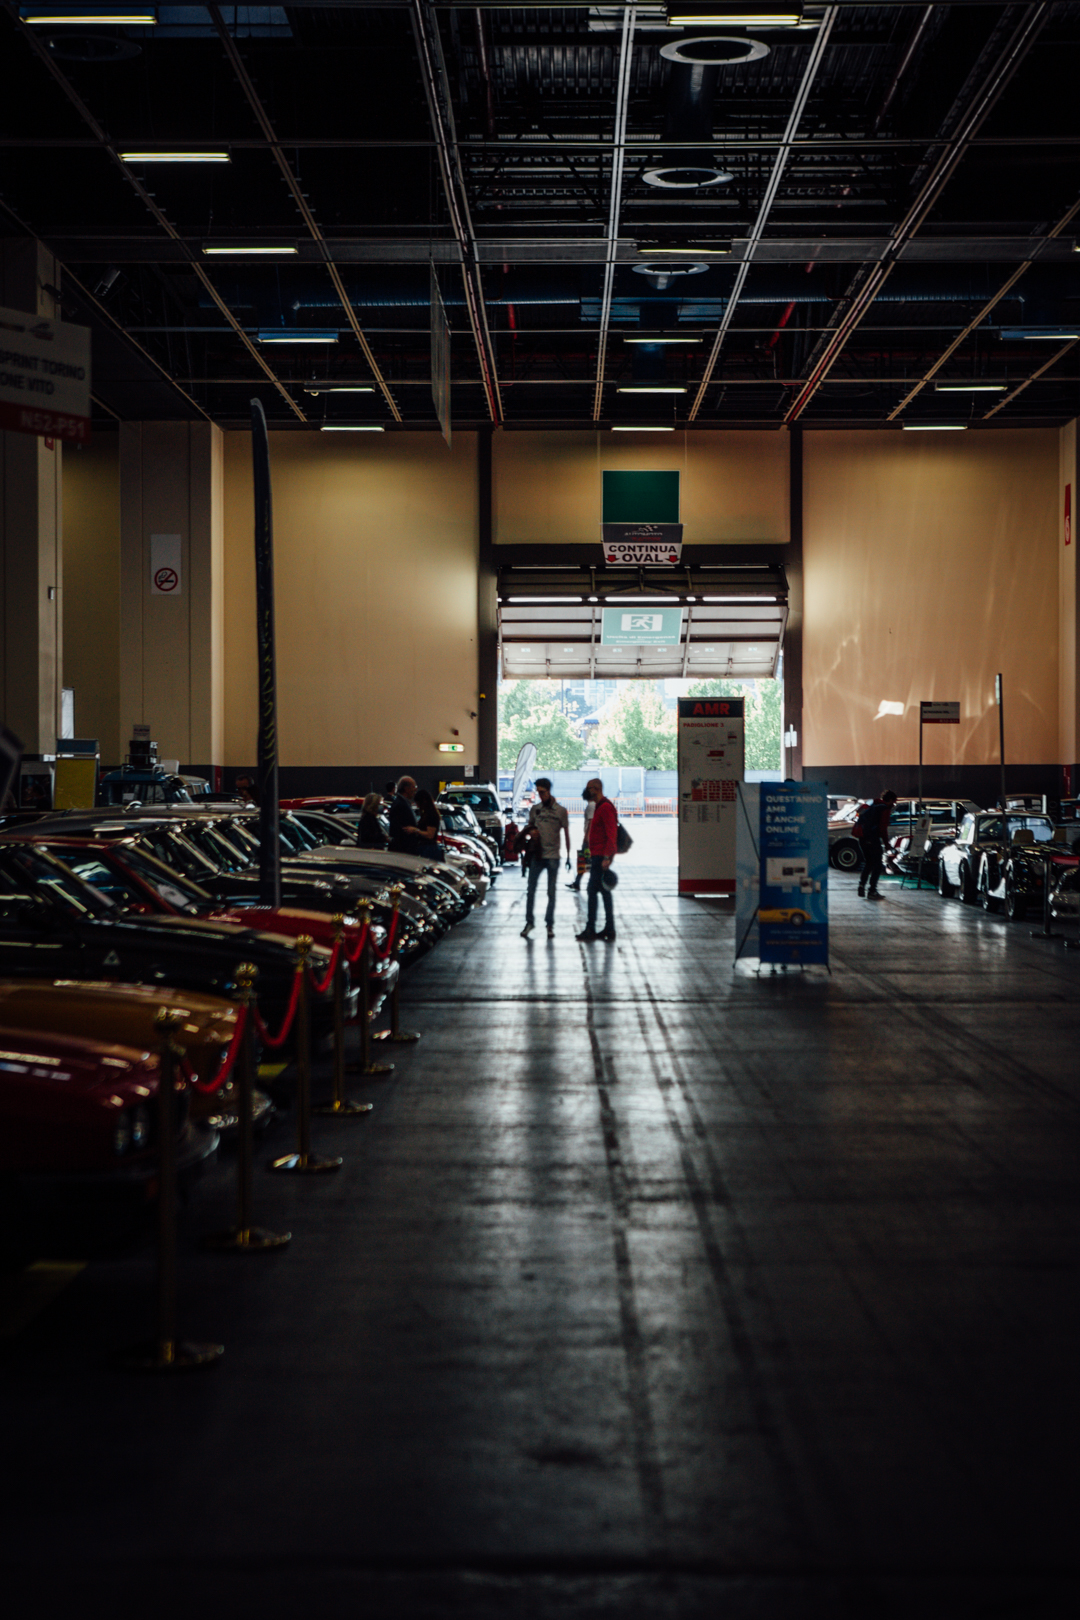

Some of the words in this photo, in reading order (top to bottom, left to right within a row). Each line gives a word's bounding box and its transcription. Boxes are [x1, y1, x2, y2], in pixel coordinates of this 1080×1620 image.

[609, 545, 677, 553] CONTINUA
[622, 553, 663, 563] OVAL
[693, 703, 730, 715] AMR
[766, 805, 787, 813] AMR
[774, 816, 806, 824] ANCHE
[766, 825, 800, 834] ONLINE
